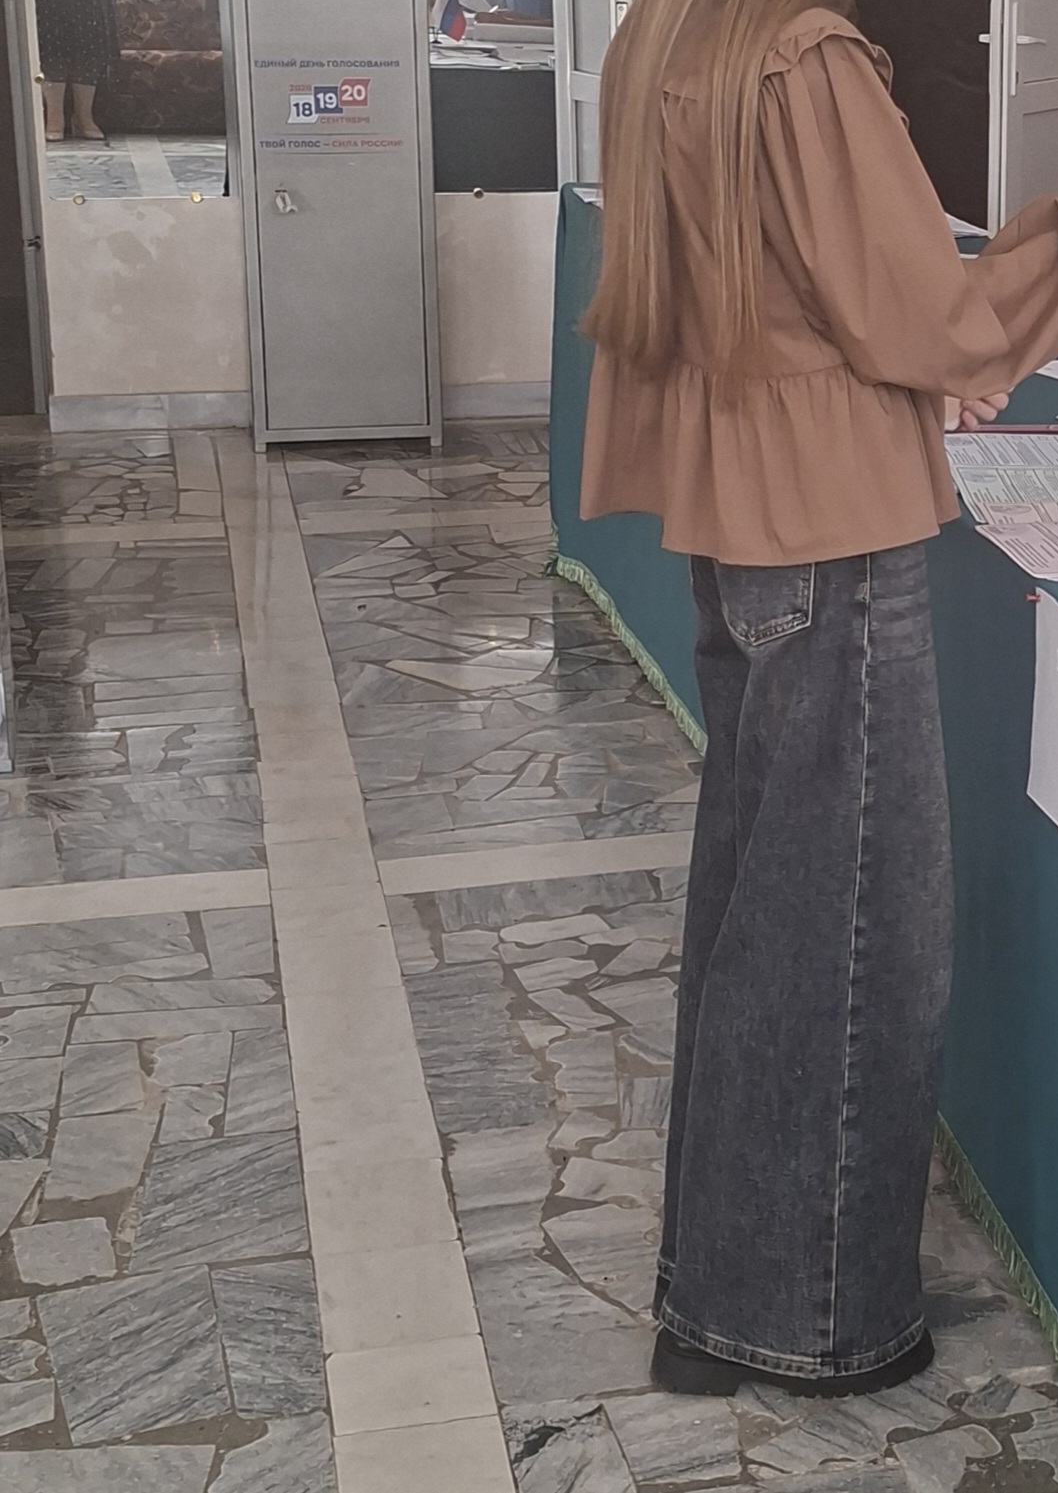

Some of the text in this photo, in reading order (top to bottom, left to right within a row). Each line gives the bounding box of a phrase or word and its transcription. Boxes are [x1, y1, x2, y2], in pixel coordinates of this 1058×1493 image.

[254, 59, 400, 68] ЕДИНЫЙ ДЕНЬ ГОЛОСОВАНИЯ
[293, 85, 366, 117] 18 19 20
[320, 117, 370, 125] СЕНТЯБРЯ
[259, 139, 286, 148] ТВОЙ
[289, 140, 321, 148] ГОЛОС
[332, 140, 358, 148] СИЛА
